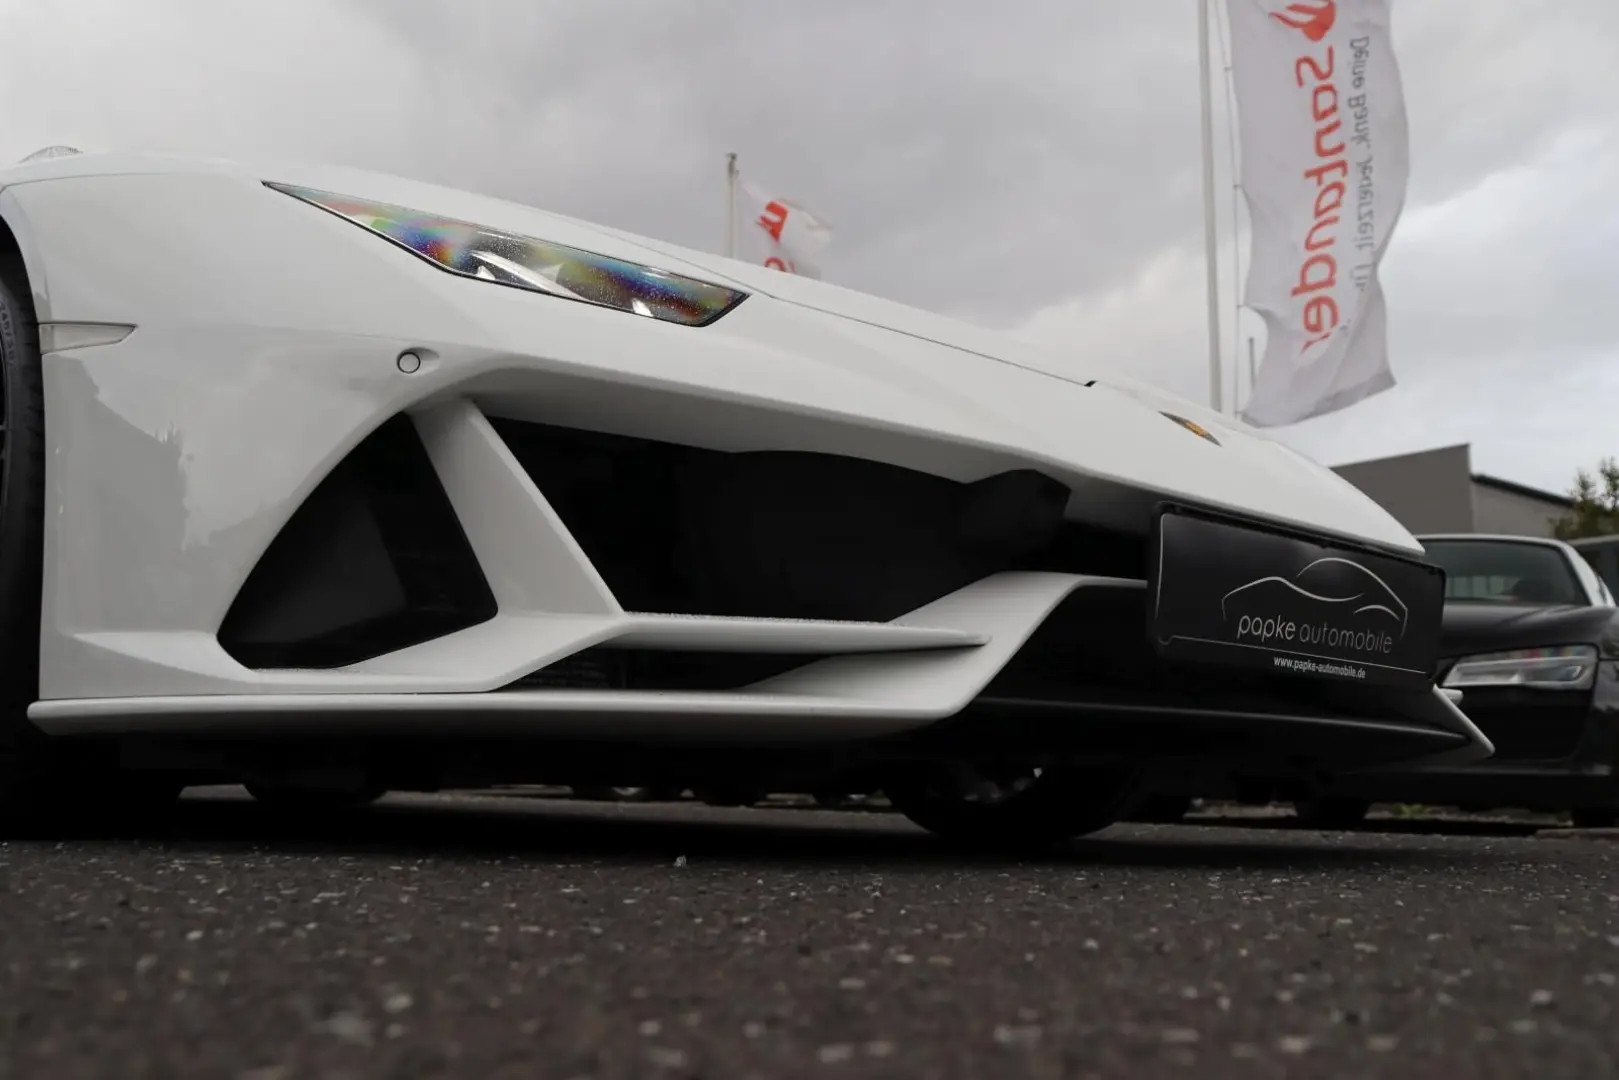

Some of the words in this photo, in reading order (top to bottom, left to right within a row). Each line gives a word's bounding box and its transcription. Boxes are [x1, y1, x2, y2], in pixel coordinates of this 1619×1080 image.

[1237, 615, 1296, 641] papke
[1300, 622, 1393, 653] automobile
[1274, 656, 1366, 679] www.papke-automobile.de
